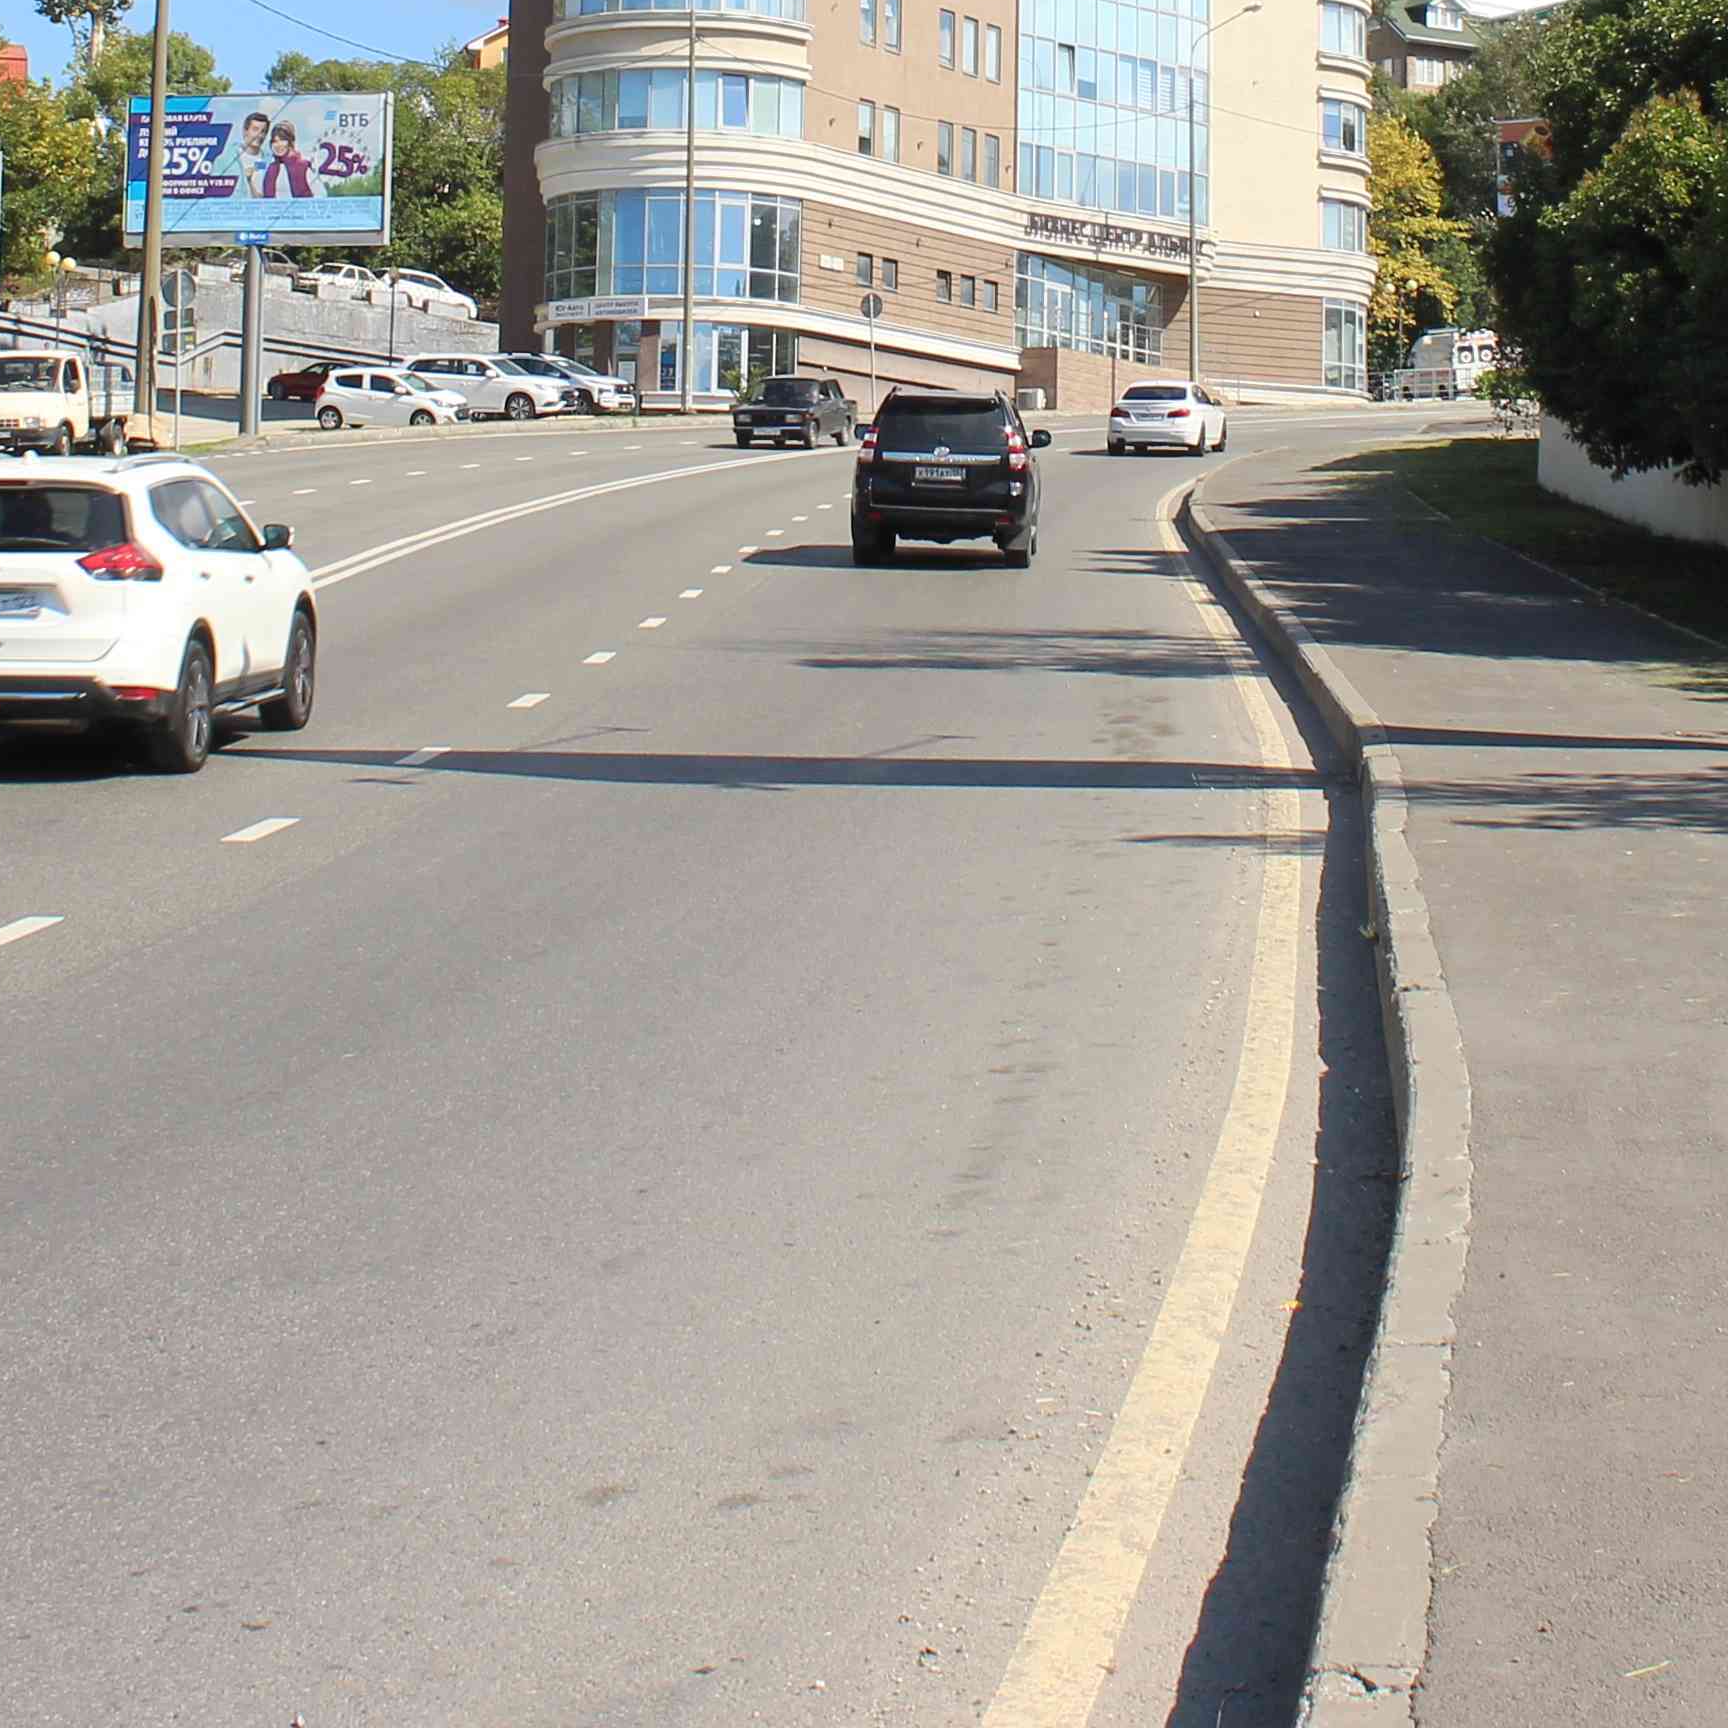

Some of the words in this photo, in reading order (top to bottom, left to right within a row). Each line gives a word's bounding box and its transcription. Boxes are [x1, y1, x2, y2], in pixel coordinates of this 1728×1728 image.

[338, 112, 369, 128] ВТБ
[161, 147, 213, 176] 25%
[319, 142, 368, 177] 25%
